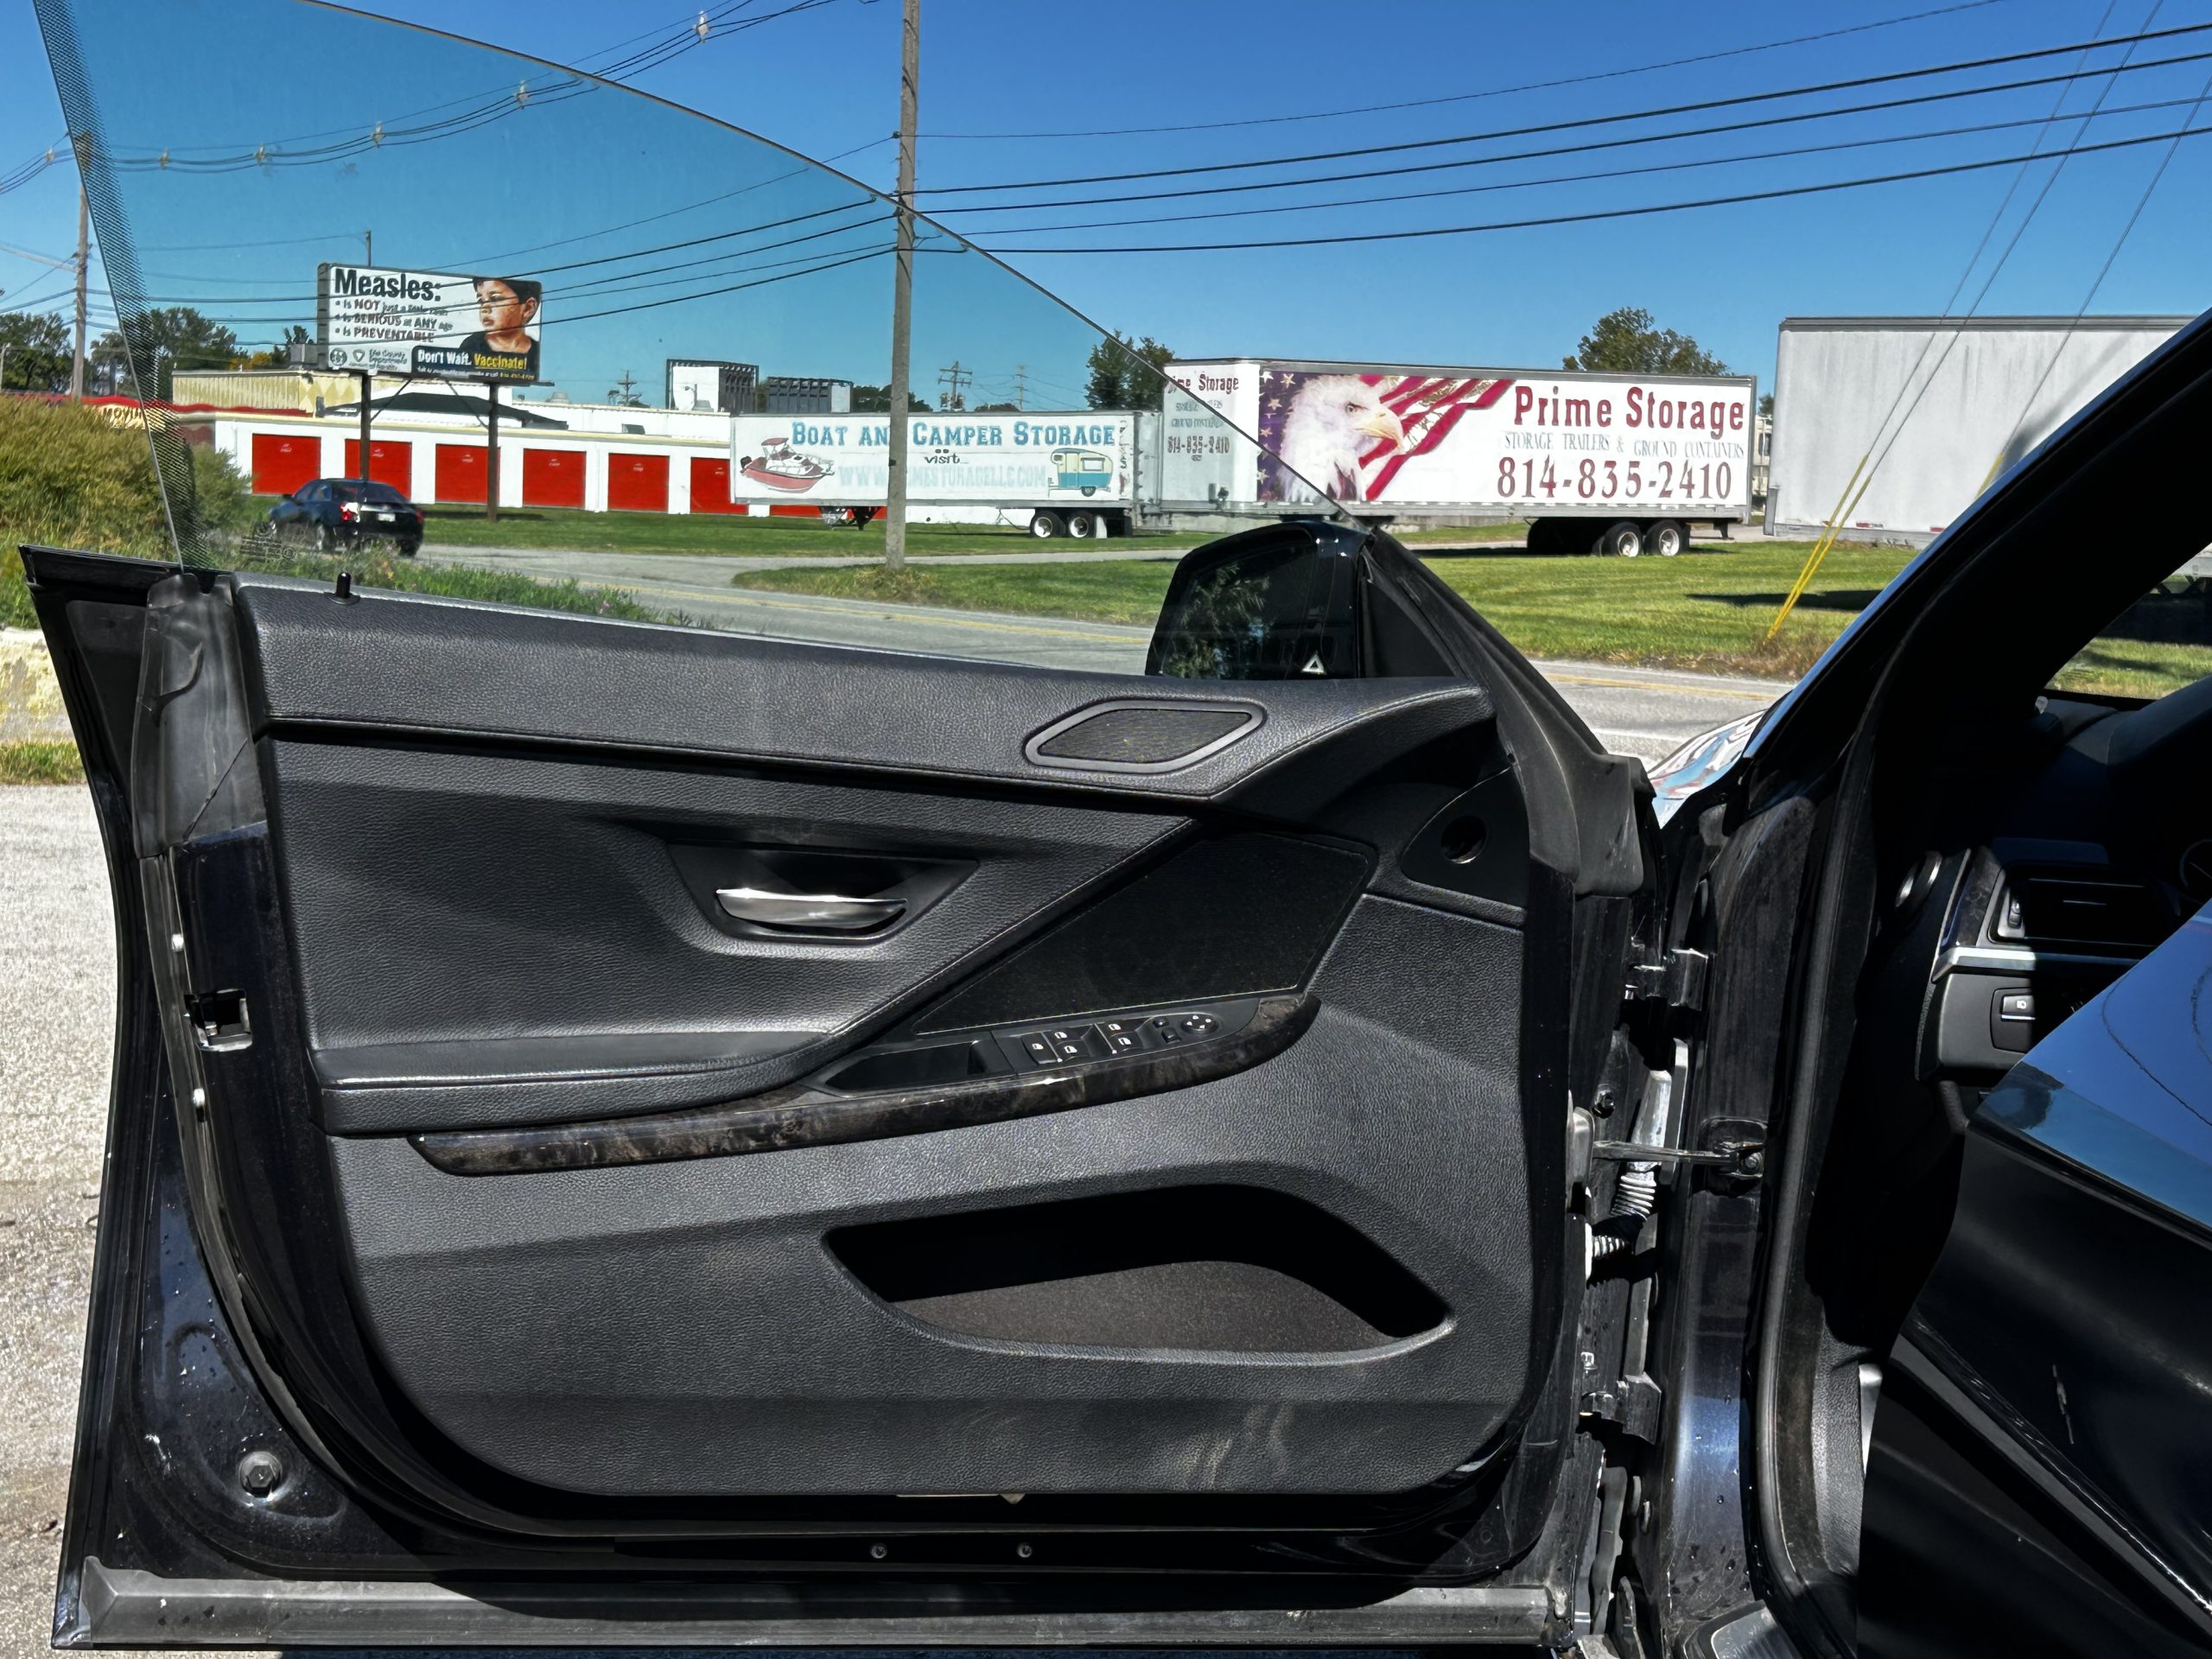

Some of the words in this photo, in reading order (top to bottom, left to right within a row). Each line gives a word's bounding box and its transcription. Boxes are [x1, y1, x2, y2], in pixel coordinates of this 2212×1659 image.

[334, 268, 442, 302] Measles:
[343, 300, 352, 309] Is
[354, 299, 381, 311] NOT
[353, 314, 402, 327] SERIOUS
[414, 317, 438, 329] ANY
[343, 327, 351, 337] Is
[353, 327, 435, 343] PREVENTABLE
[417, 349, 444, 364] Don't
[446, 352, 473, 365] Wait.
[474, 353, 528, 370] Vaccinate!
[1198, 374, 1239, 394] Storage
[1514, 385, 1612, 428] Prime
[1626, 386, 1745, 440] Storage
[792, 422, 849, 446] BOAT
[858, 426, 890, 446] AN
[912, 422, 1002, 447] CAMPER
[1014, 421, 1116, 446] STORAGE
[1167, 435, 1230, 454] 814-835-2410
[1504, 431, 1554, 450] STORAGE
[1562, 433, 1610, 452] TRAILERS
[1616, 435, 1624, 454] &
[1634, 440, 1677, 458] GROUND
[1685, 441, 1745, 460] CONTAINERS
[1497, 454, 1732, 499] 814-835-2410
